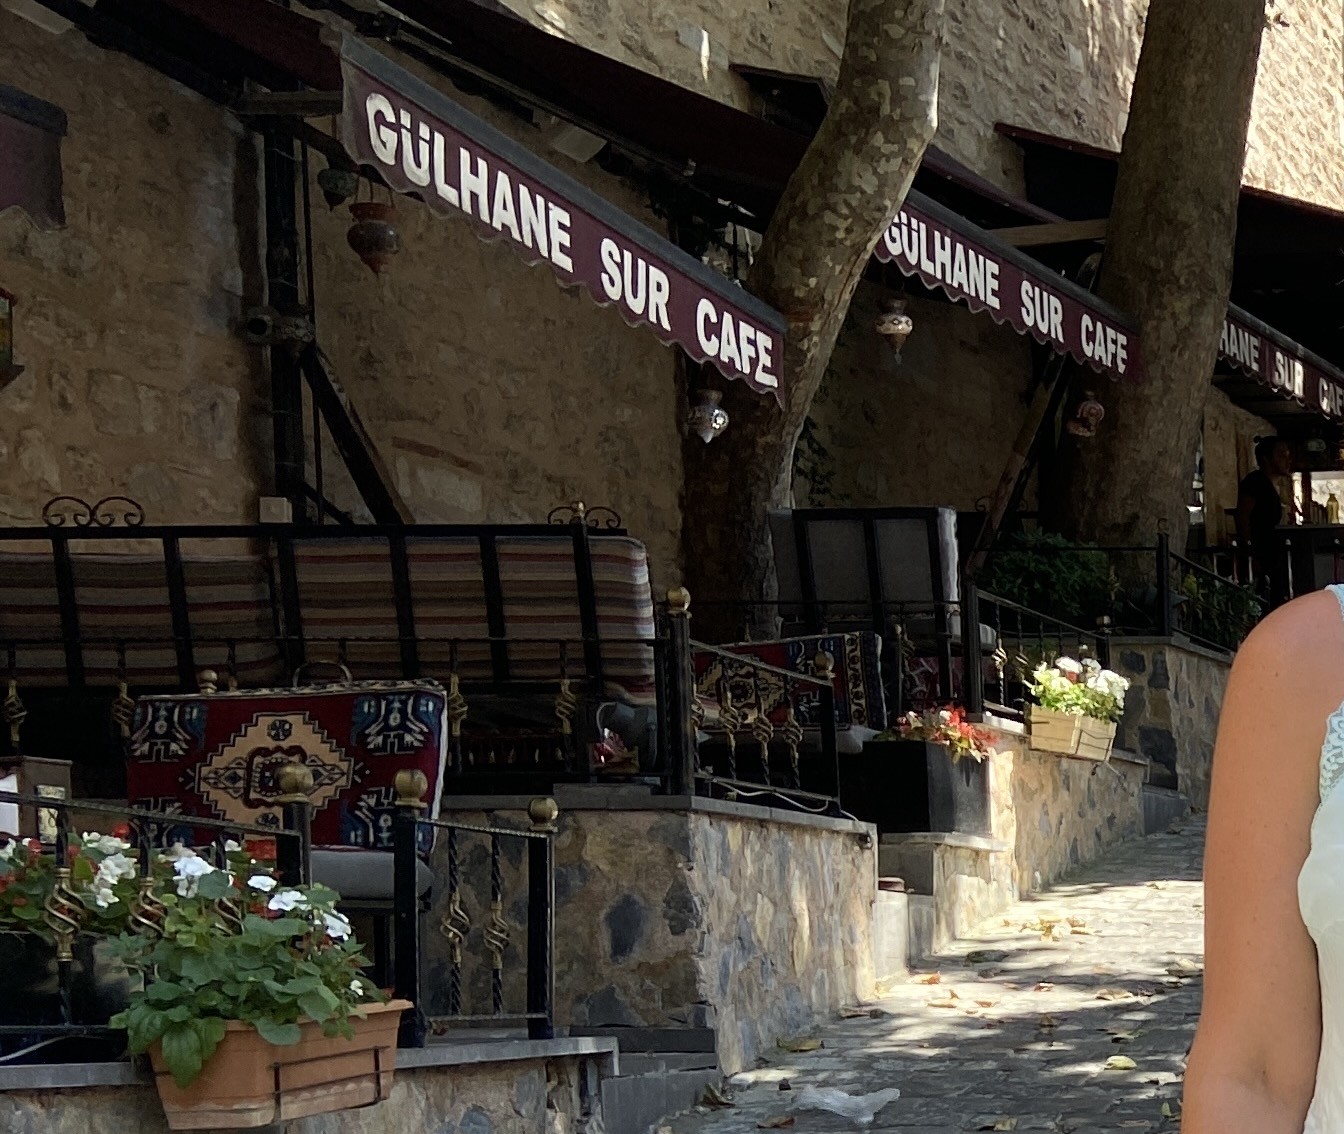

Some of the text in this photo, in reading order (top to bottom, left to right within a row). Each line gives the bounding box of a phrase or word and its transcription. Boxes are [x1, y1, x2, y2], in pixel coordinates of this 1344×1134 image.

[366, 93, 778, 388] GÜLHANE SUR CAFE
[884, 211, 1128, 374] GÜLHANE SUR CAFE
[1219, 319, 1259, 372] HANE
[1274, 351, 1304, 397] SUR
